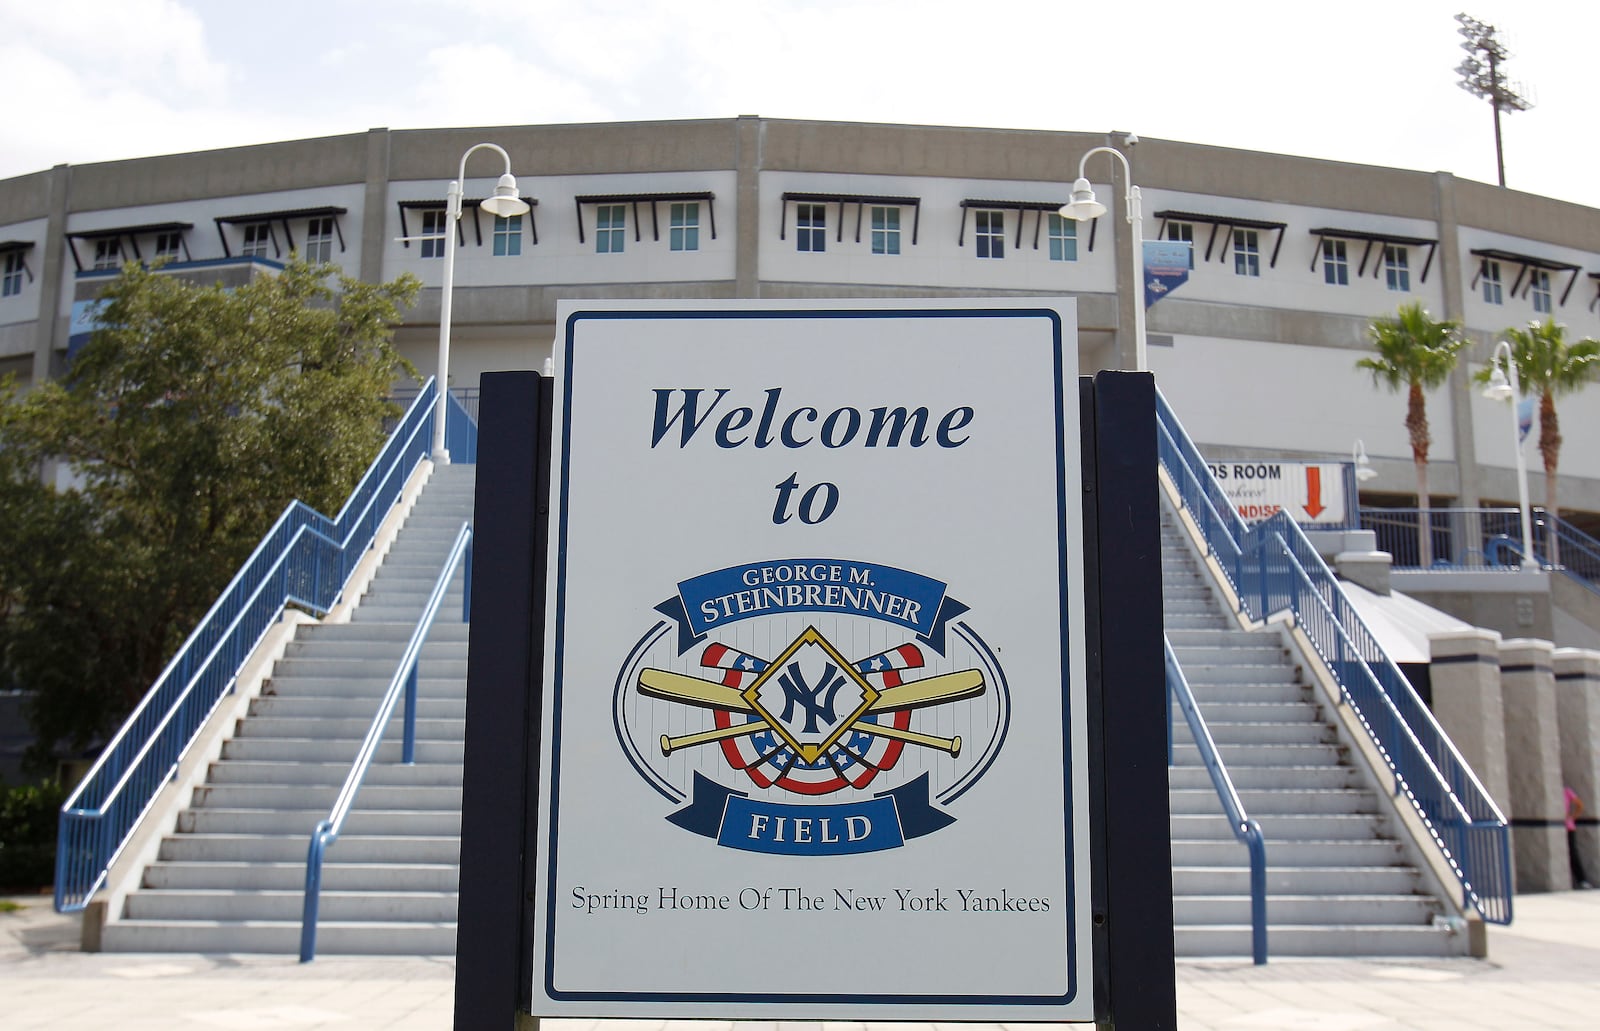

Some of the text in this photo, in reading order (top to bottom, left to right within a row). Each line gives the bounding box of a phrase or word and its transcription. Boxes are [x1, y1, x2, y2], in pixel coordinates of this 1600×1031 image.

[651, 387, 974, 449] Welcome
[1233, 464, 1281, 479] ROOM
[772, 471, 840, 525] to
[742, 564, 876, 587] GEORGE M.
[699, 585, 922, 625] STEINBRENNER
[748, 813, 873, 844] FIELD
[571, 886, 1050, 915] Spring Home Of The New York Yankees
